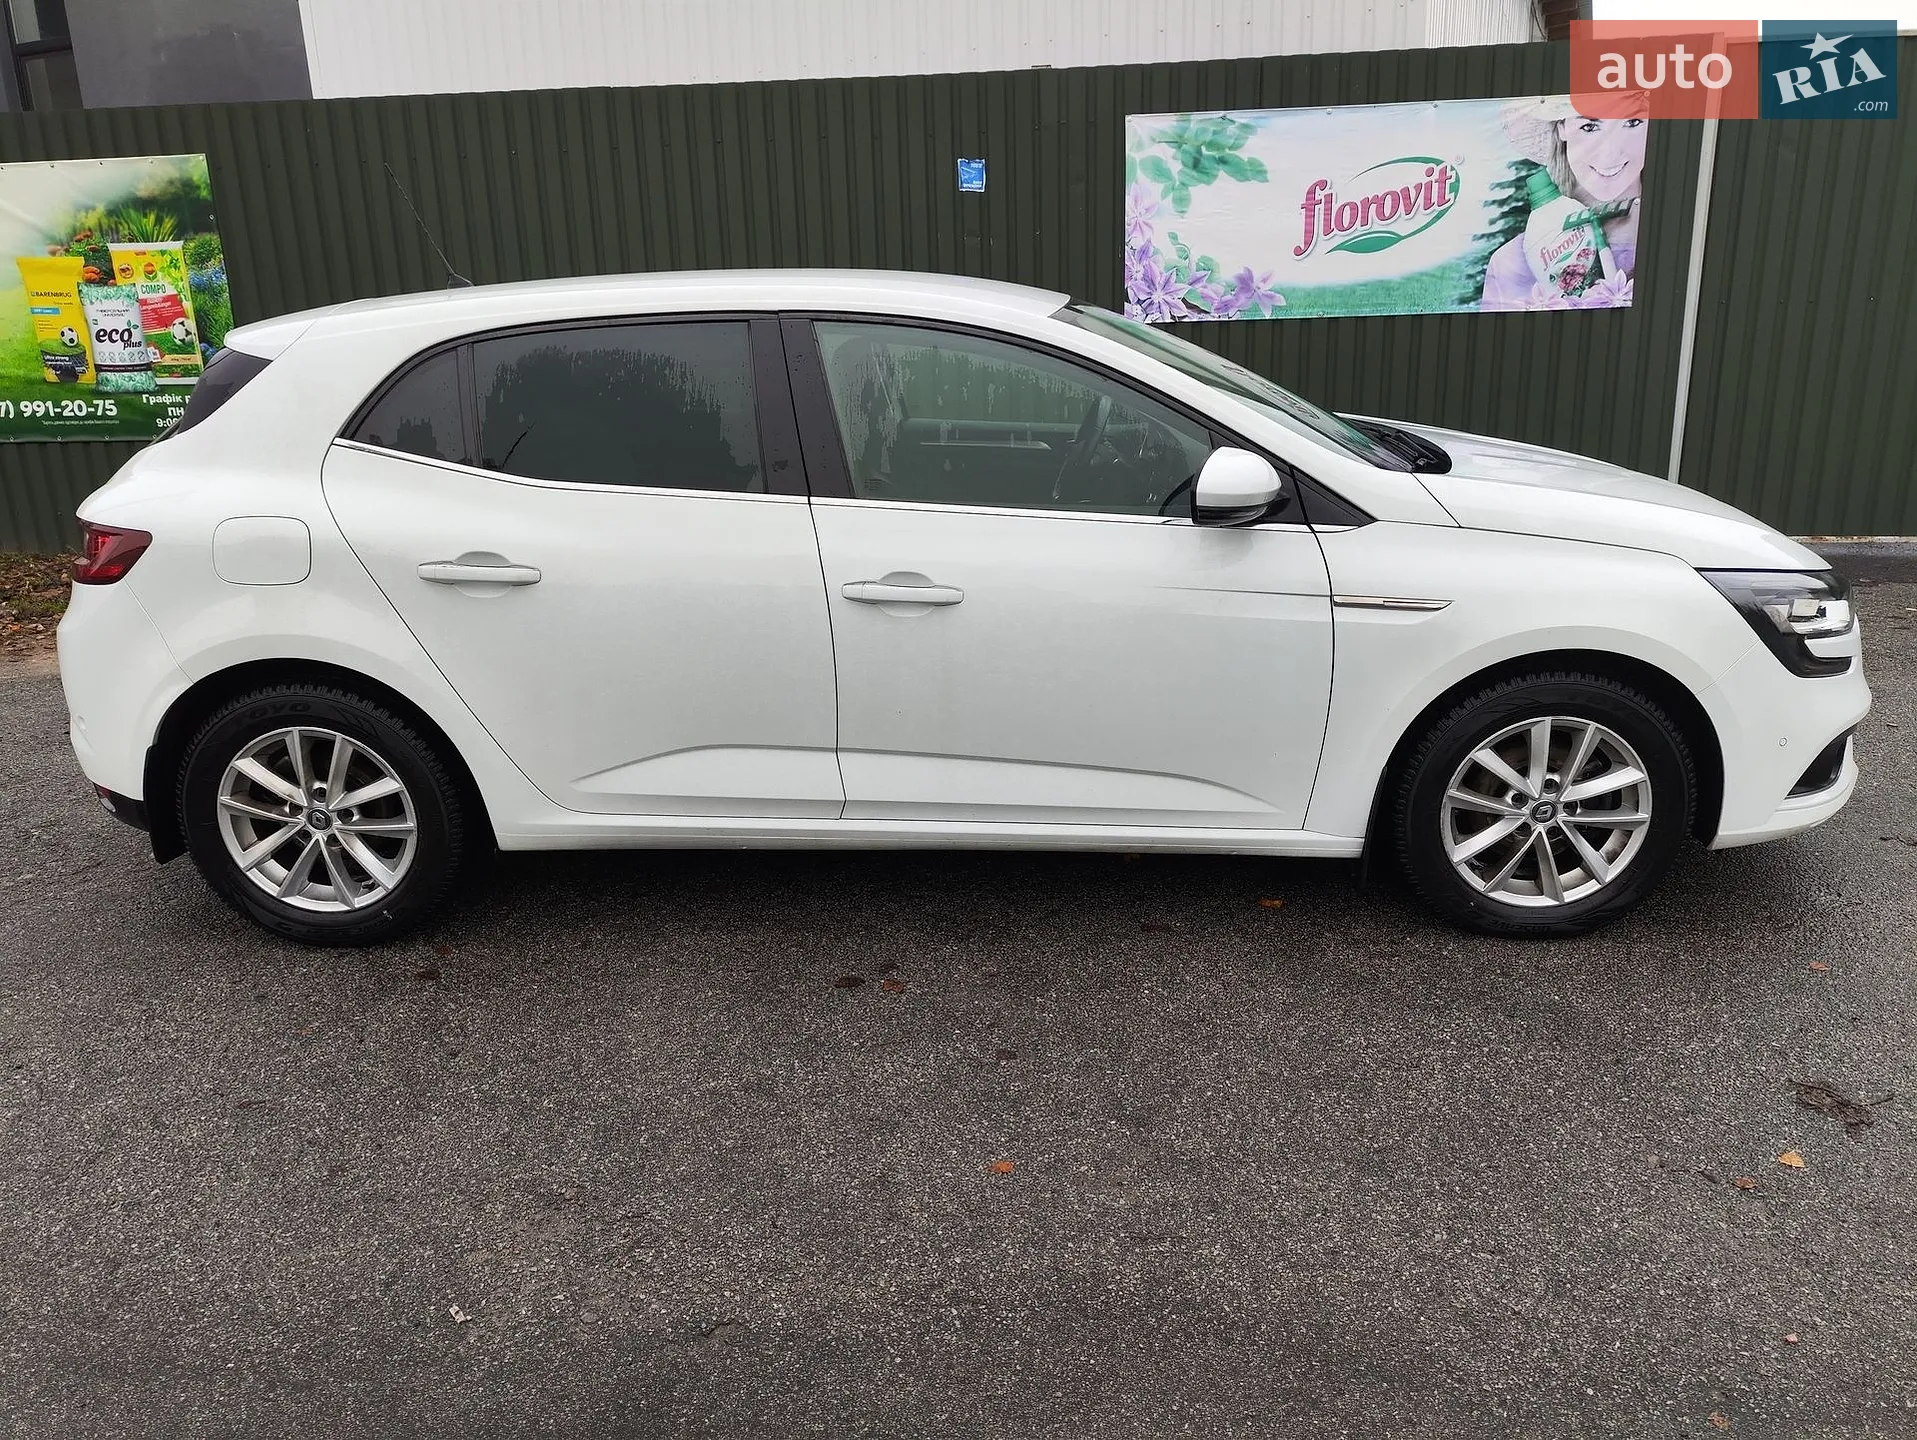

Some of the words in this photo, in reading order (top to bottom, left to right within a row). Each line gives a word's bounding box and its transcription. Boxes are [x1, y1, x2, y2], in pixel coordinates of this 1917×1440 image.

[1293, 164, 1453, 257] florovit
[141, 283, 167, 295] COMPO
[95, 328, 133, 344] eco
[123, 340, 142, 351] plus
[142, 393, 183, 405] Графік
[20, 399, 118, 418] 991-20-75
